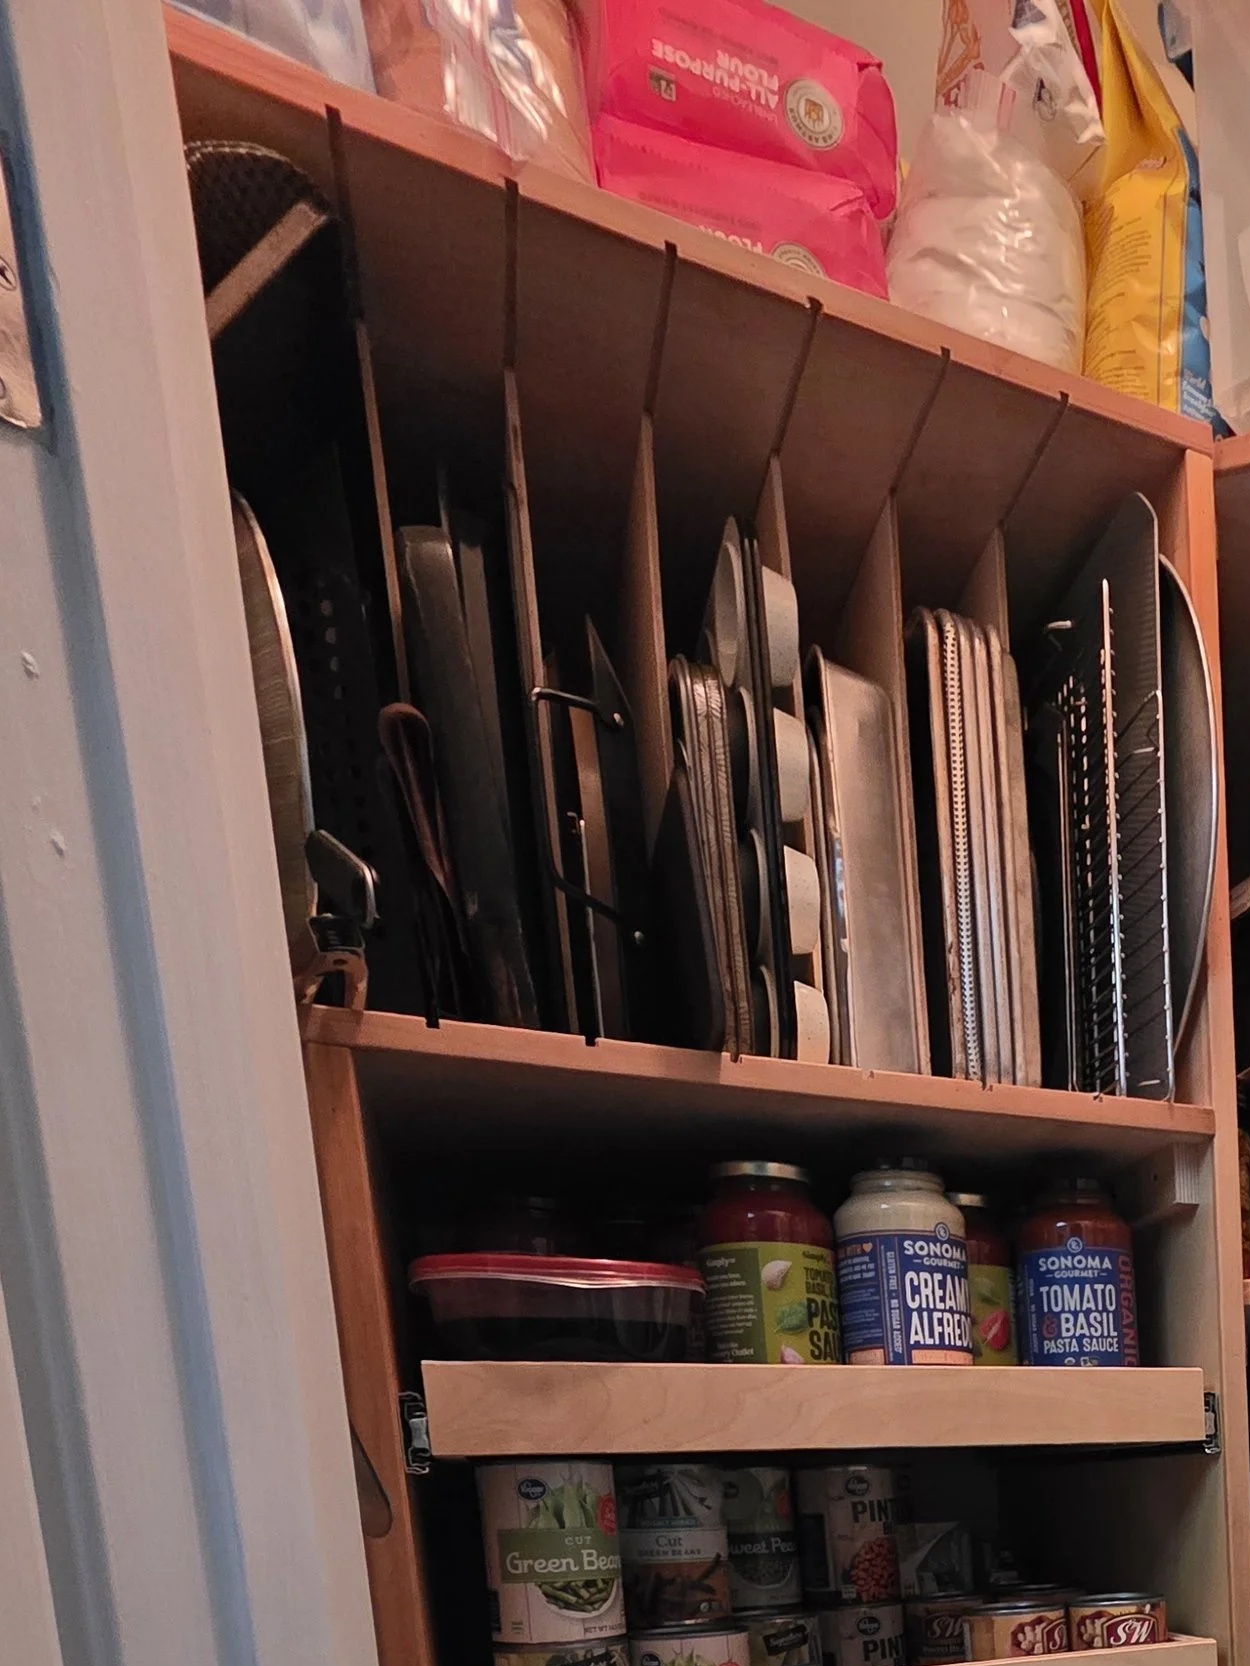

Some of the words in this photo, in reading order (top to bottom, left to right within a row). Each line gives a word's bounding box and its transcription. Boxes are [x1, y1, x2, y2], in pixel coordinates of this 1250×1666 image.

[651, 38, 779, 109] ALL-PURPOSE
[716, 50, 779, 93] FLOUR
[903, 1240, 967, 1262] SONOMA
[923, 1257, 961, 1269] GOURMET
[1038, 1254, 1112, 1271] SONOMA
[1053, 1269, 1099, 1279] GOURMET
[904, 1271, 970, 1314] CREAM
[1039, 1283, 1116, 1313] TOMATO
[1042, 1314, 1058, 1339] &
[1060, 1312, 1118, 1338] BASIL
[1043, 1338, 1079, 1355] PASTA
[1083, 1338, 1119, 1353] SAUCE
[564, 1535, 593, 1546] CUT
[655, 1535, 684, 1548] Cut
[505, 1551, 580, 1574] Green
